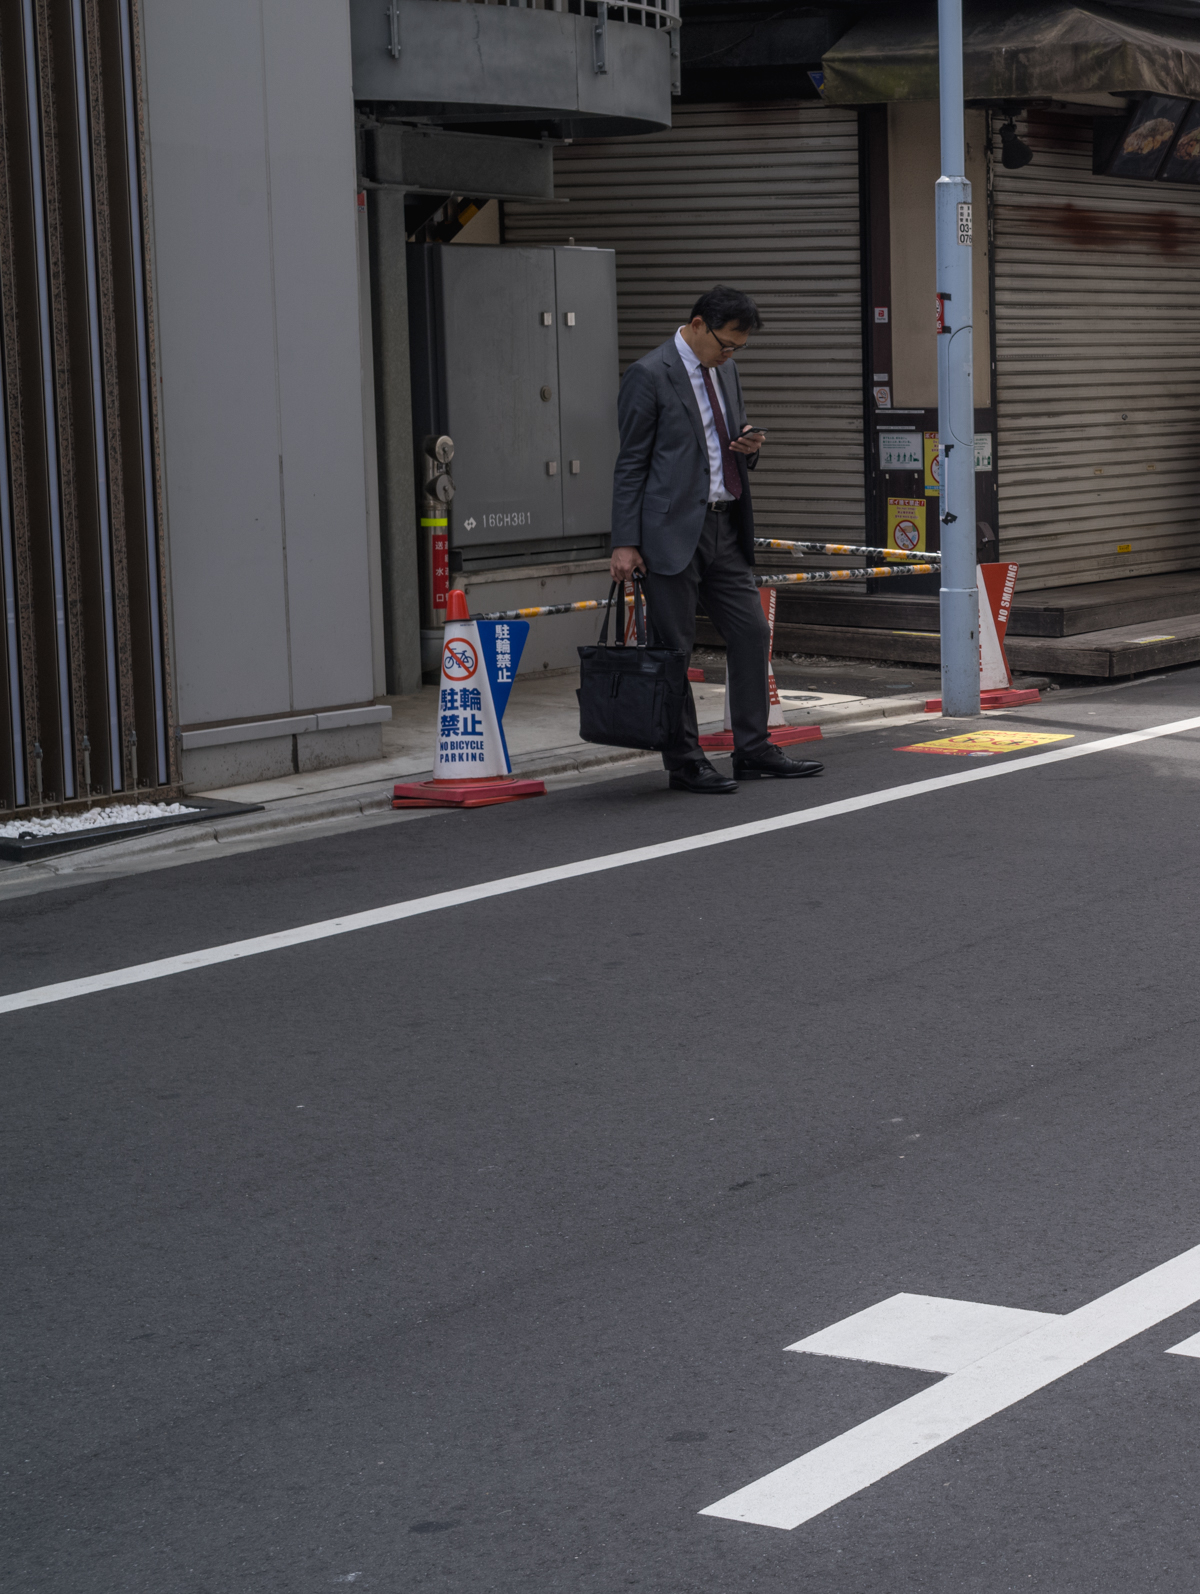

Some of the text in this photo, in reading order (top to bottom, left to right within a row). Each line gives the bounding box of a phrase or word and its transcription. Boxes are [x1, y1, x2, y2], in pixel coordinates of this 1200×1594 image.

[482, 512, 531, 528] 16CH381
[435, 540, 445, 603] 送水口
[997, 564, 1018, 623] NO SMOKING
[495, 624, 512, 683] 駐輪禁止
[440, 688, 482, 711] 駐輪
[440, 714, 484, 737] 禁止
[440, 741, 485, 751] NO BICYCLE
[440, 753, 485, 763] PARKING
